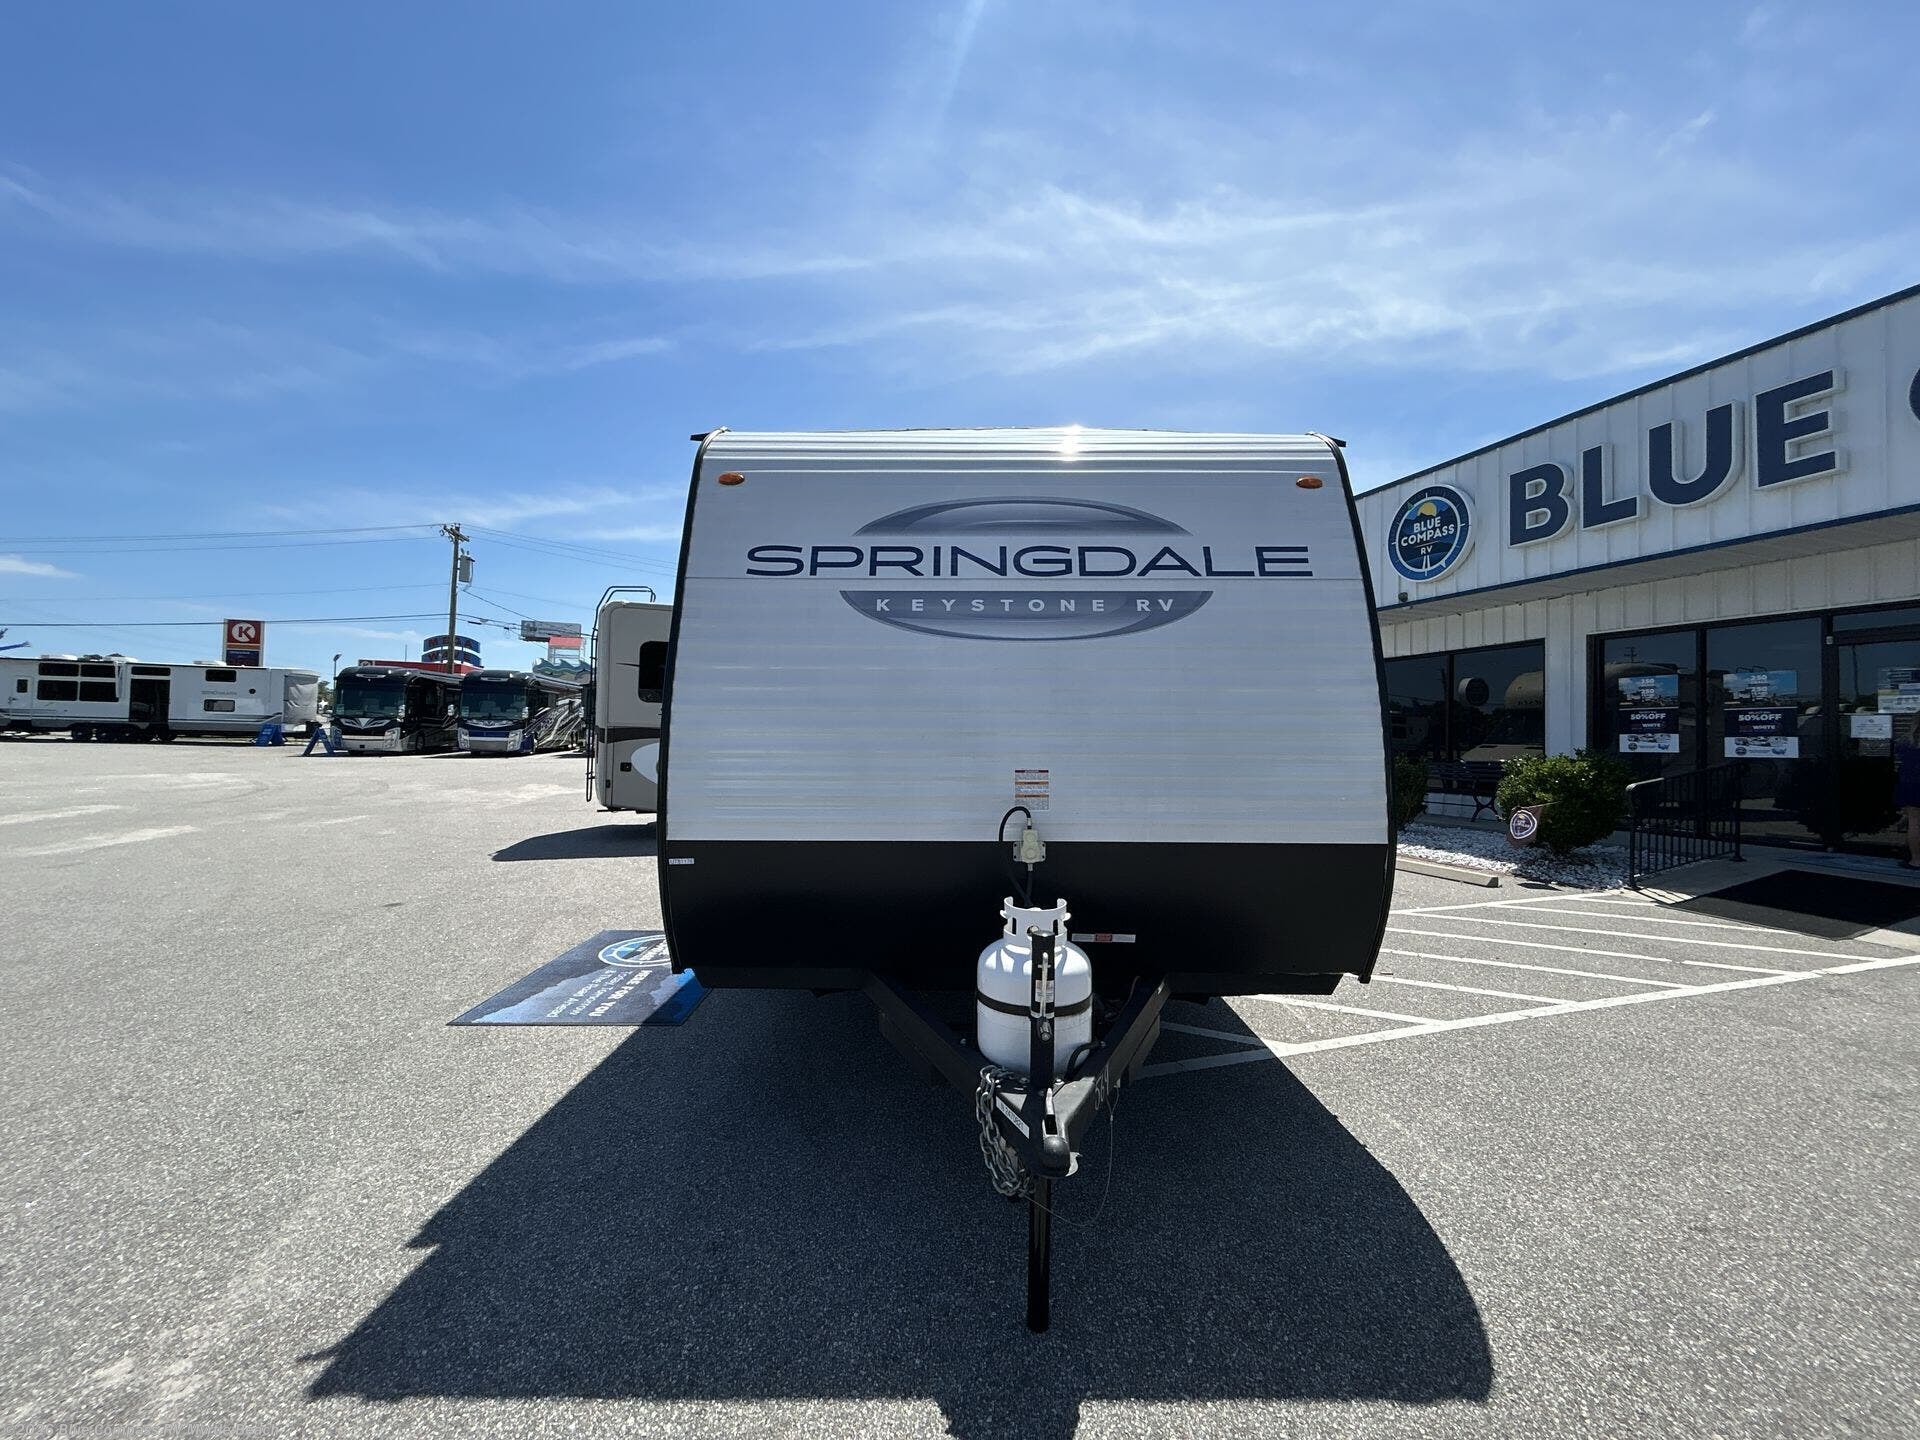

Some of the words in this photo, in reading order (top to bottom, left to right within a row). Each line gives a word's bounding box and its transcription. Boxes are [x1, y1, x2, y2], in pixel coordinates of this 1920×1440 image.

[1509, 368, 1843, 547] BLUE
[1413, 516, 1441, 533] BLUE
[1401, 524, 1455, 547] COMPASS
[1420, 545, 1433, 555] RV
[745, 545, 1314, 578] SPRINGDALE
[876, 598, 1106, 612] KEYSTONE
[1136, 598, 1175, 612] RV
[238, 626, 254, 639] K
[607, 986, 634, 999] FOR
[588, 1001, 617, 1017] YOU
